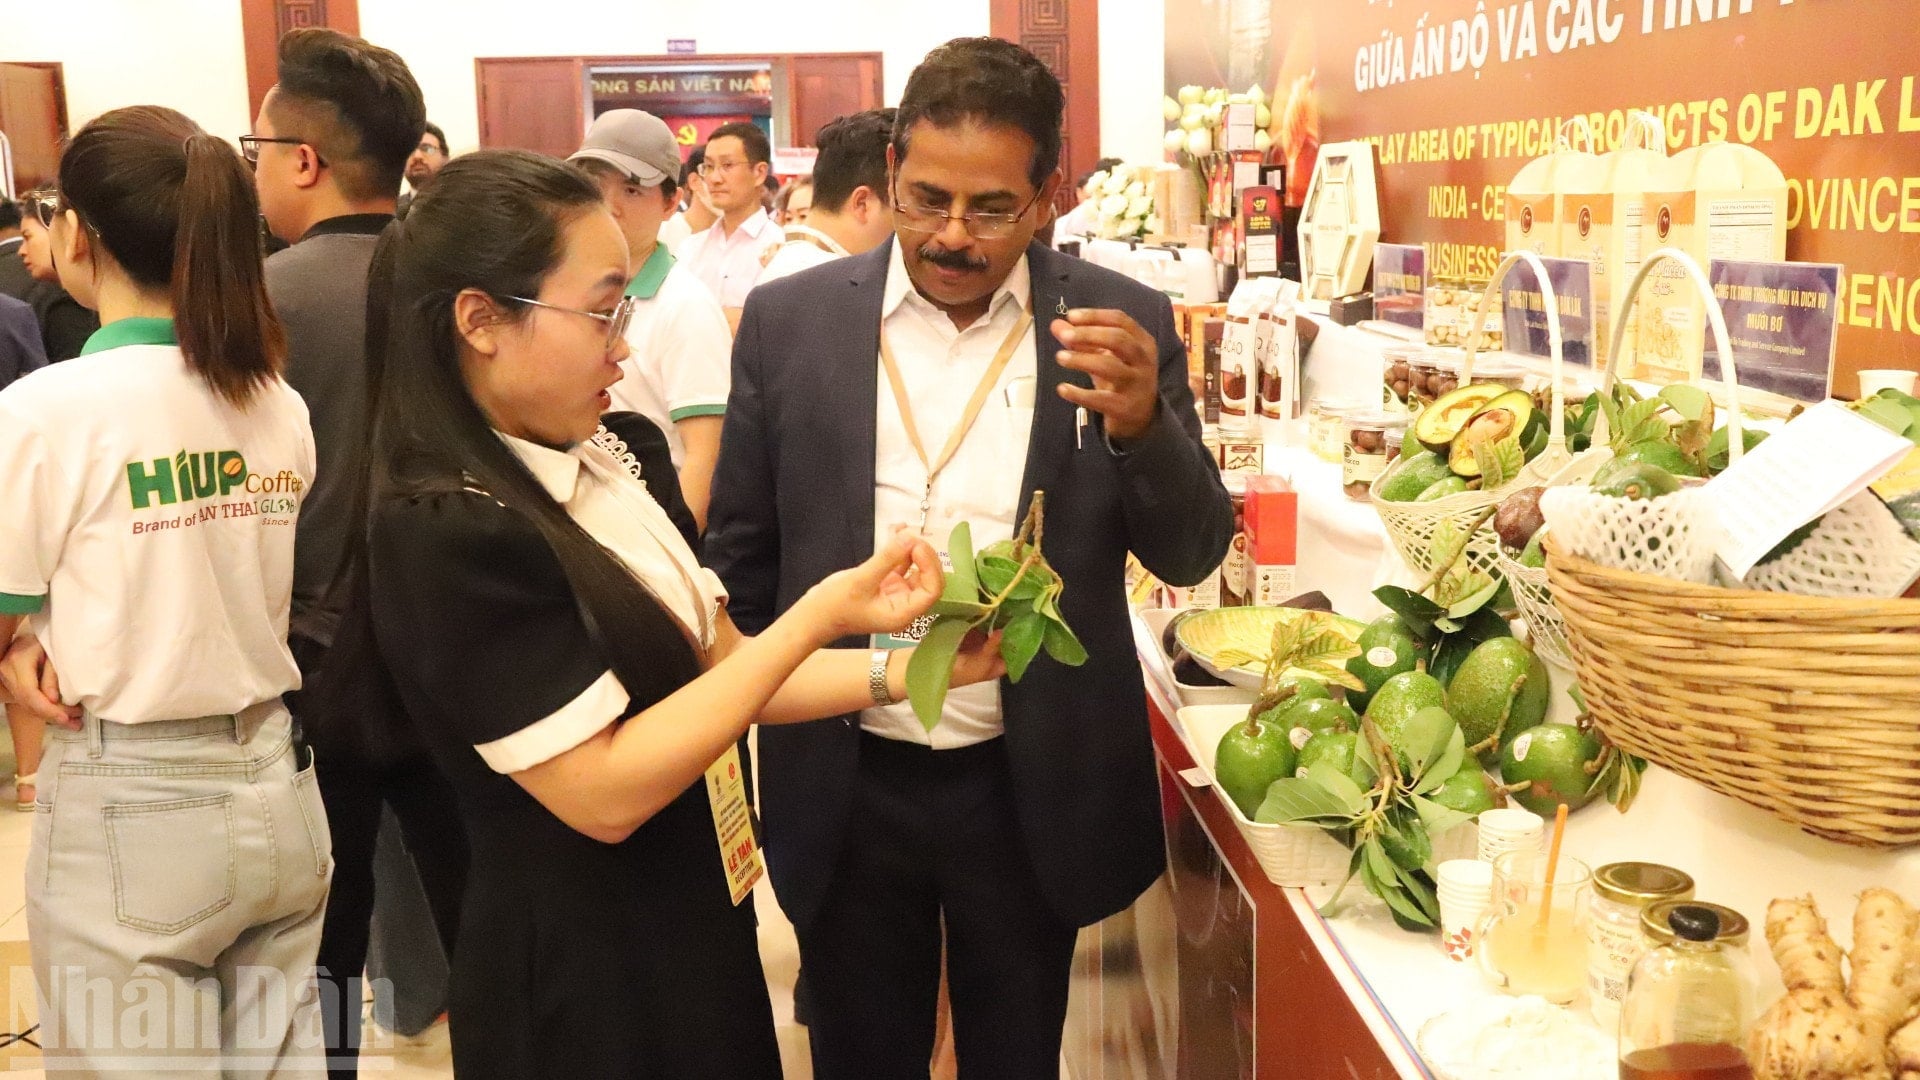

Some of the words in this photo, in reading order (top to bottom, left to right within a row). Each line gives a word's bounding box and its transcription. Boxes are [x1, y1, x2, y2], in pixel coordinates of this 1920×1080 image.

[1354, 29, 1405, 92] GIỮA
[1410, 12, 1446, 80] ẤN
[1450, 0, 1489, 79] ĐỘ
[1407, 129, 1449, 162] AREA
[1453, 125, 1477, 161] OF
[1737, 90, 1787, 144] OF
[1794, 79, 1887, 139] DAK
[1428, 185, 1467, 219] INDIA
[1482, 184, 1508, 221] CE
[132, 516, 181, 534] Brand
[184, 513, 197, 527] of
[199, 505, 216, 522] AN
[221, 501, 258, 519] THAI
[260, 498, 297, 514] GLOB
